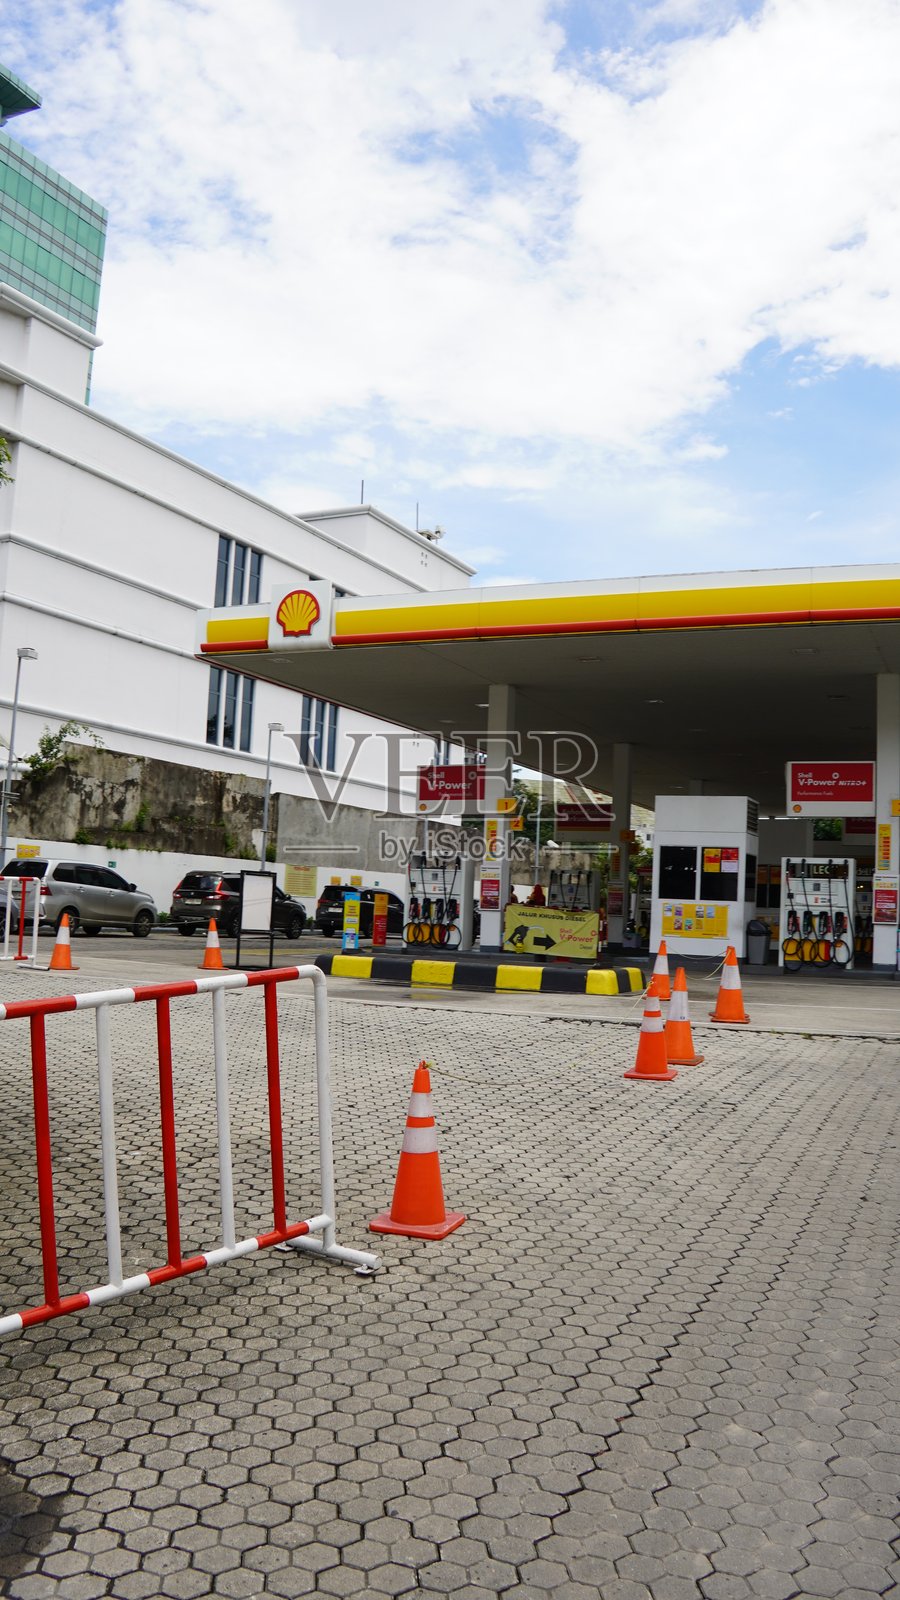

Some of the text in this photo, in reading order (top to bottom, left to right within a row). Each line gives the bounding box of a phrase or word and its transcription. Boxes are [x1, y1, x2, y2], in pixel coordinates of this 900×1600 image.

[428, 771, 445, 779] Shell
[429, 781, 472, 789] V-Power
[513, 820, 521, 828] 2
[539, 913, 563, 921] KHUSUS
[560, 934, 593, 942] V-Power
